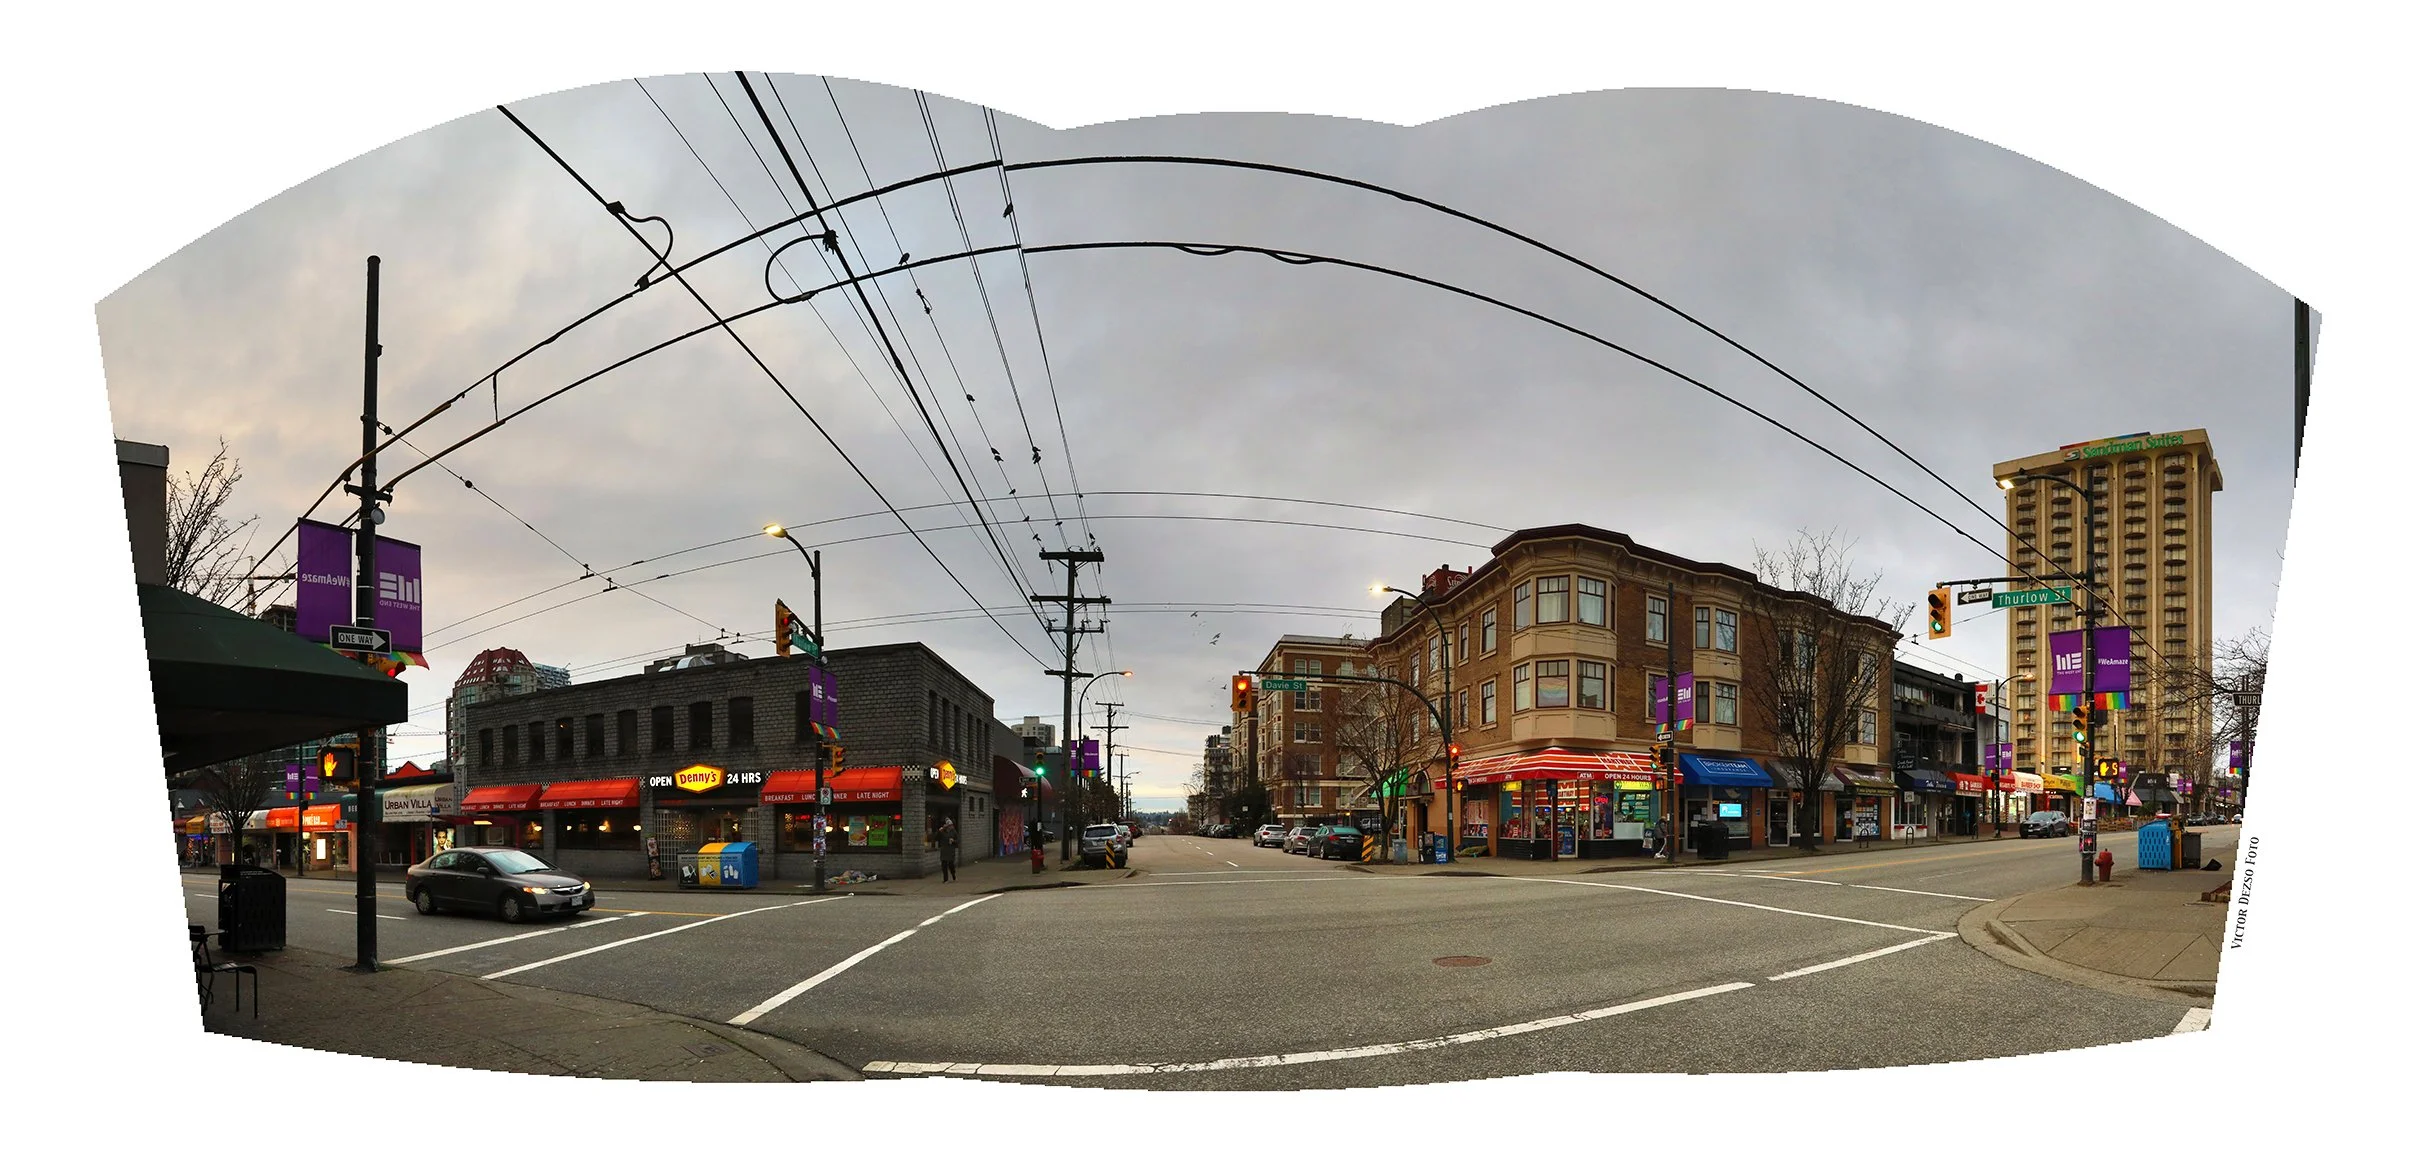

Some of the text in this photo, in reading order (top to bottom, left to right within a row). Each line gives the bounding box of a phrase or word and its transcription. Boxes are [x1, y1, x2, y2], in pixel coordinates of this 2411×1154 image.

[2083, 434, 2184, 458] Sandman Suites
[1999, 590, 2066, 606] Thurlow St
[339, 633, 374, 644] ONE WAY
[2098, 658, 2129, 666] #WeAmaze
[1265, 681, 1303, 690] Davie St
[2238, 694, 2261, 705] THURL
[2112, 762, 2118, 776] 5
[649, 771, 761, 787] OPEN Denny's 24 HRS
[765, 794, 794, 802] BREAKFAST
[857, 791, 870, 799] LATE
[871, 791, 890, 799] NIGHT
[384, 799, 432, 810] URBAN VILLA
